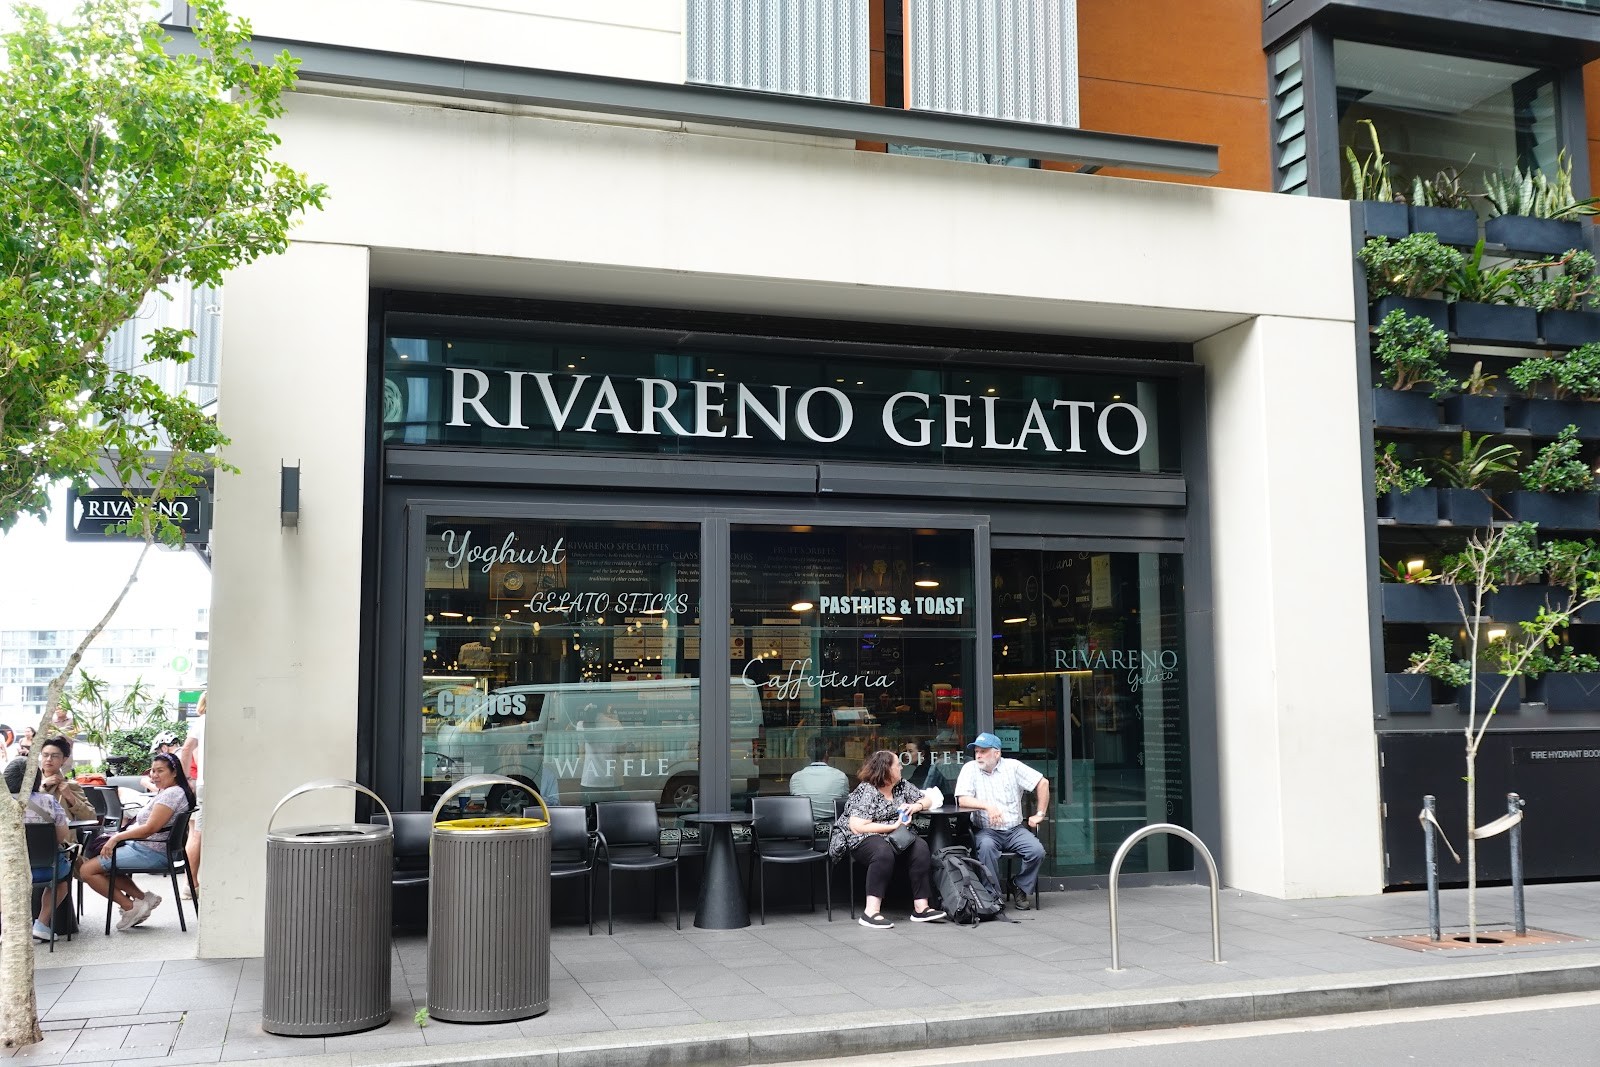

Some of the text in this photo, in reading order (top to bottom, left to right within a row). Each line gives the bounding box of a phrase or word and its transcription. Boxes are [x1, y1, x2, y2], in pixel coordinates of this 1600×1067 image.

[445, 367, 1148, 456] RIVARENO GELATO
[88, 500, 189, 518] RIVANO
[441, 529, 566, 574] Yoghurt
[567, 541, 670, 551] RIVARENO SPECIALTIES
[672, 551, 698, 559] CLASS
[730, 552, 754, 560] OURS
[529, 591, 610, 613] GELATO
[615, 592, 689, 614] STICKS
[819, 596, 965, 615] PASTRIES & TOAST
[1054, 649, 1178, 669] RIVARENO
[742, 658, 895, 701] Caffetteria
[1127, 665, 1173, 693] Gelato
[898, 750, 965, 766] OFFEE
[1531, 751, 1548, 759] FIRE
[1548, 750, 1583, 759] HYDRANT
[554, 758, 670, 778] WAFFLE
